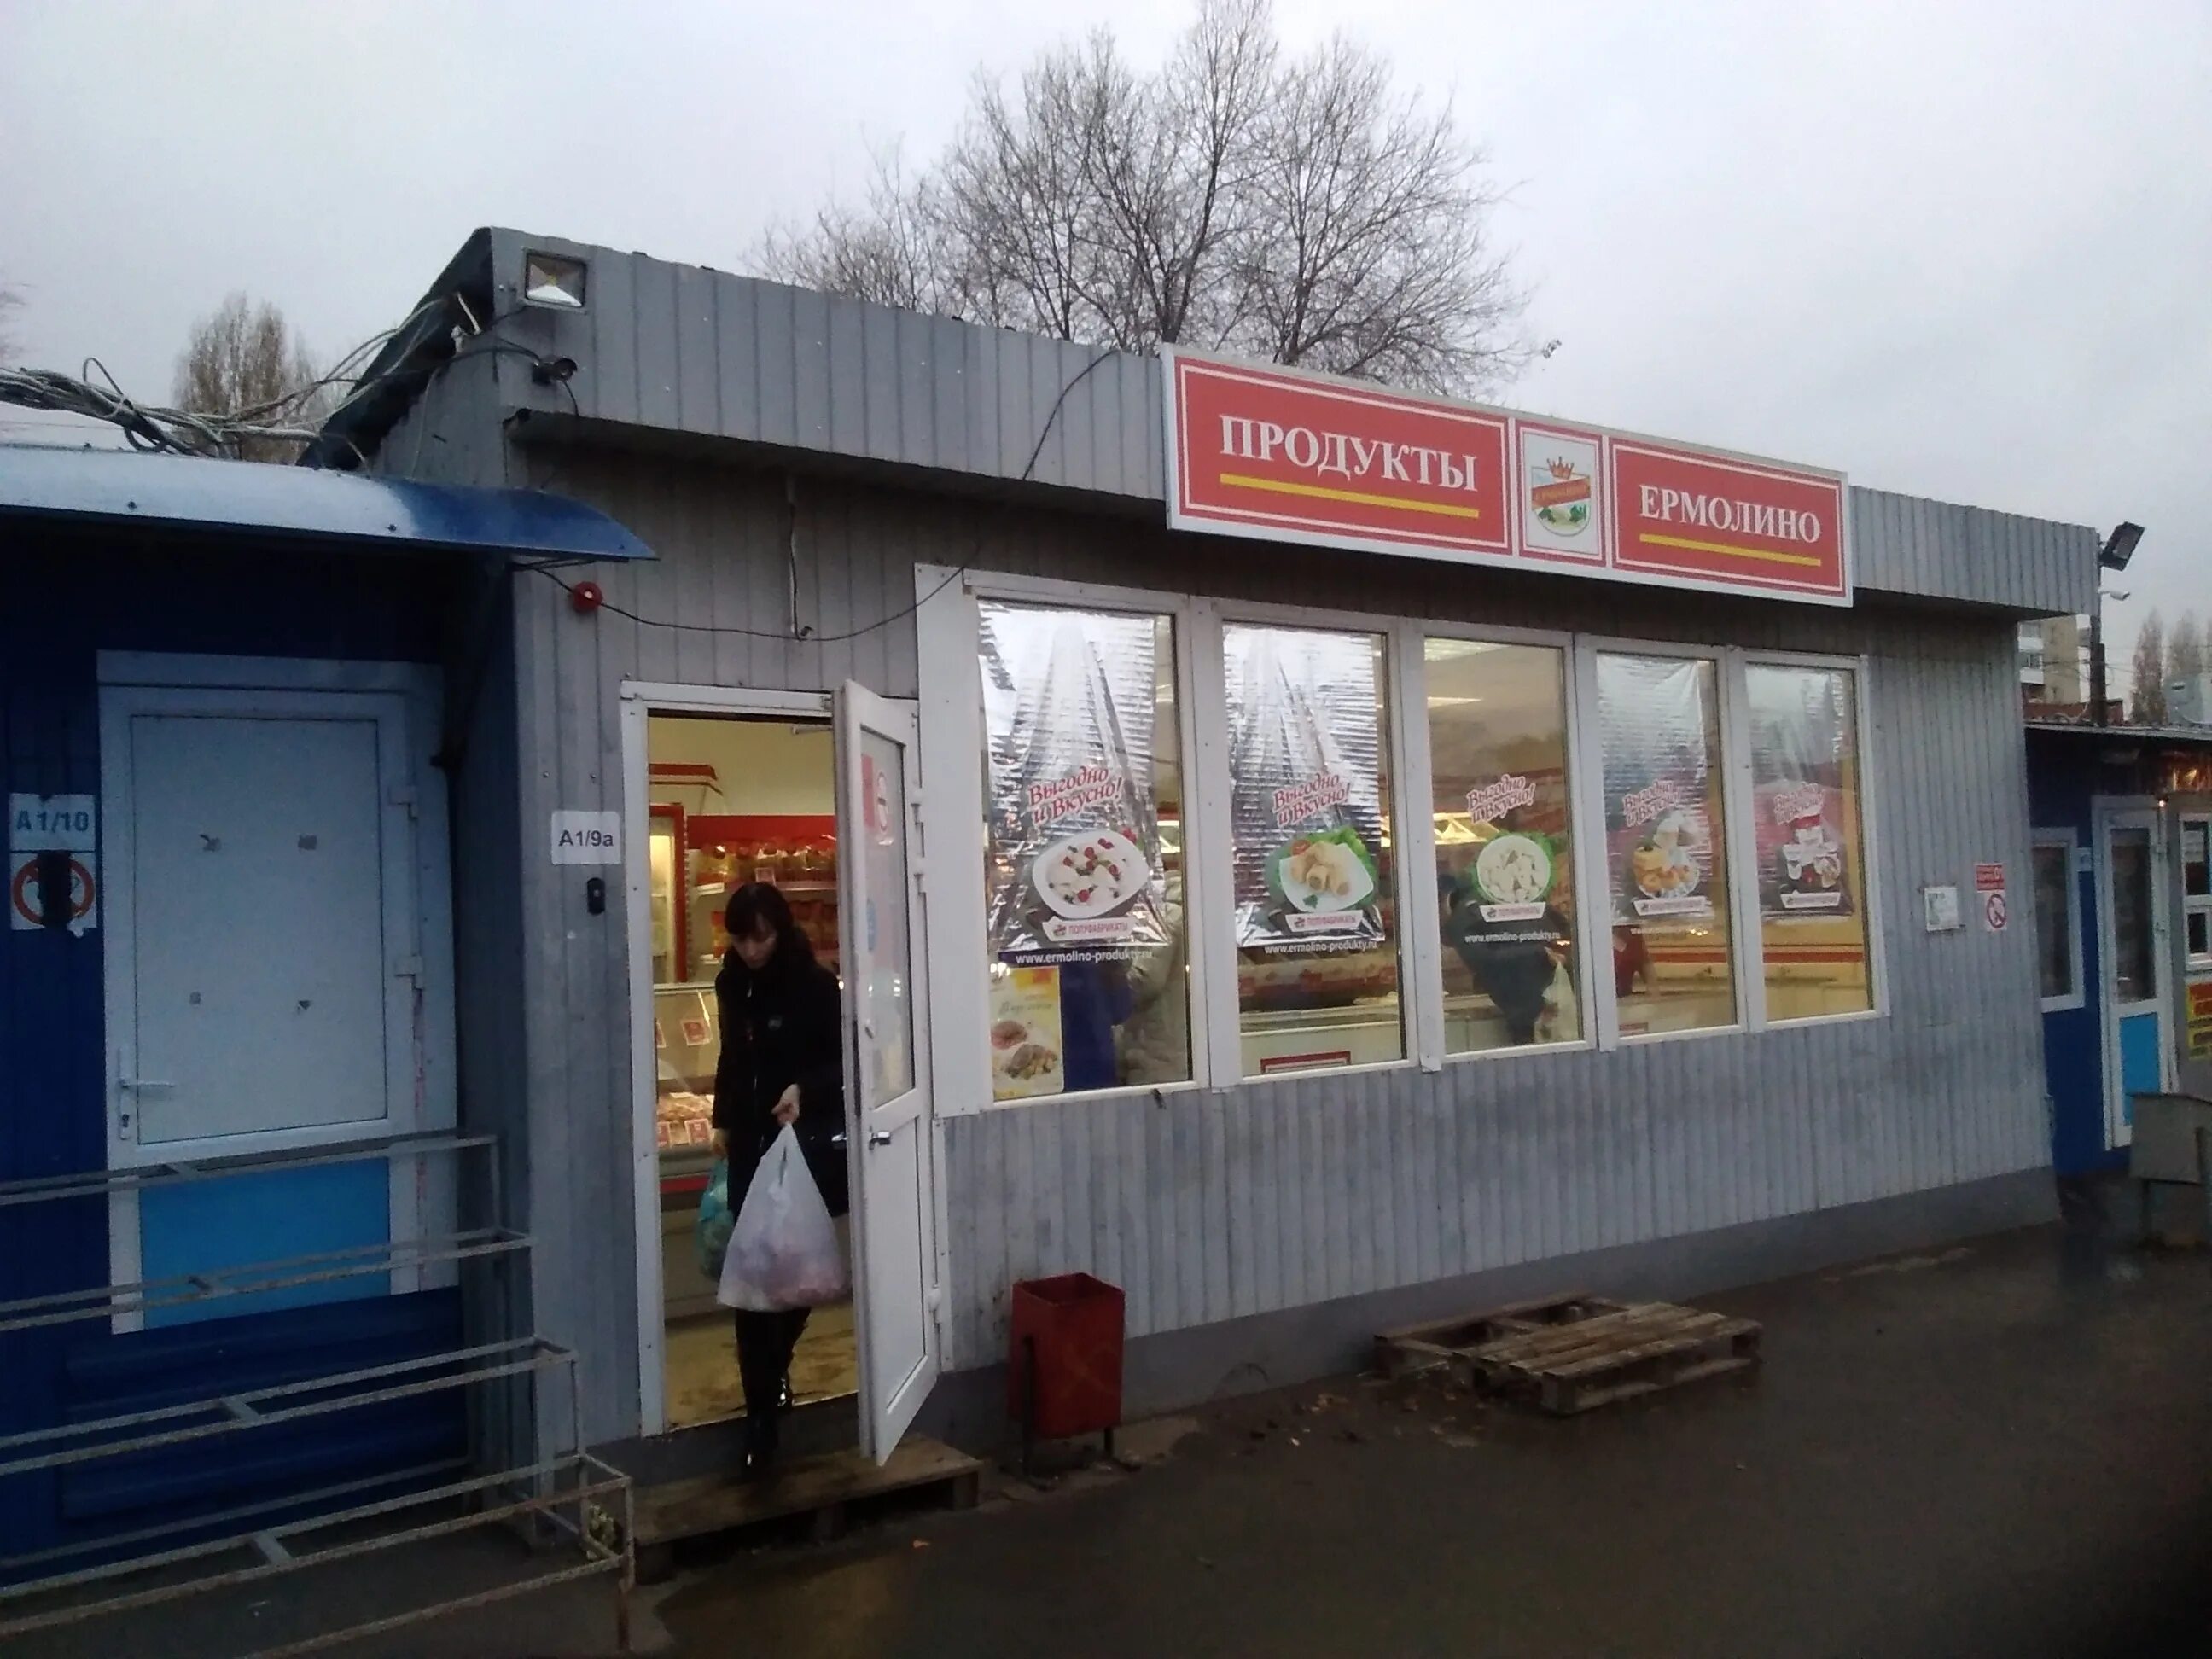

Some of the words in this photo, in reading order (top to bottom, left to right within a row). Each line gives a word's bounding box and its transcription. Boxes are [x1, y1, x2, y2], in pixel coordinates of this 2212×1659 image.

[1219, 414, 1478, 492] ПРОДУКТЫ
[1639, 484, 1821, 543] ЕРМОЛИНО
[1029, 765, 1109, 806] Выгодно
[1034, 809, 1046, 824] и
[1051, 777, 1123, 818] Вкусно!
[1273, 772, 1341, 810] Выгодно
[1264, 940, 1377, 954] www.ermolino-produkty.ru
